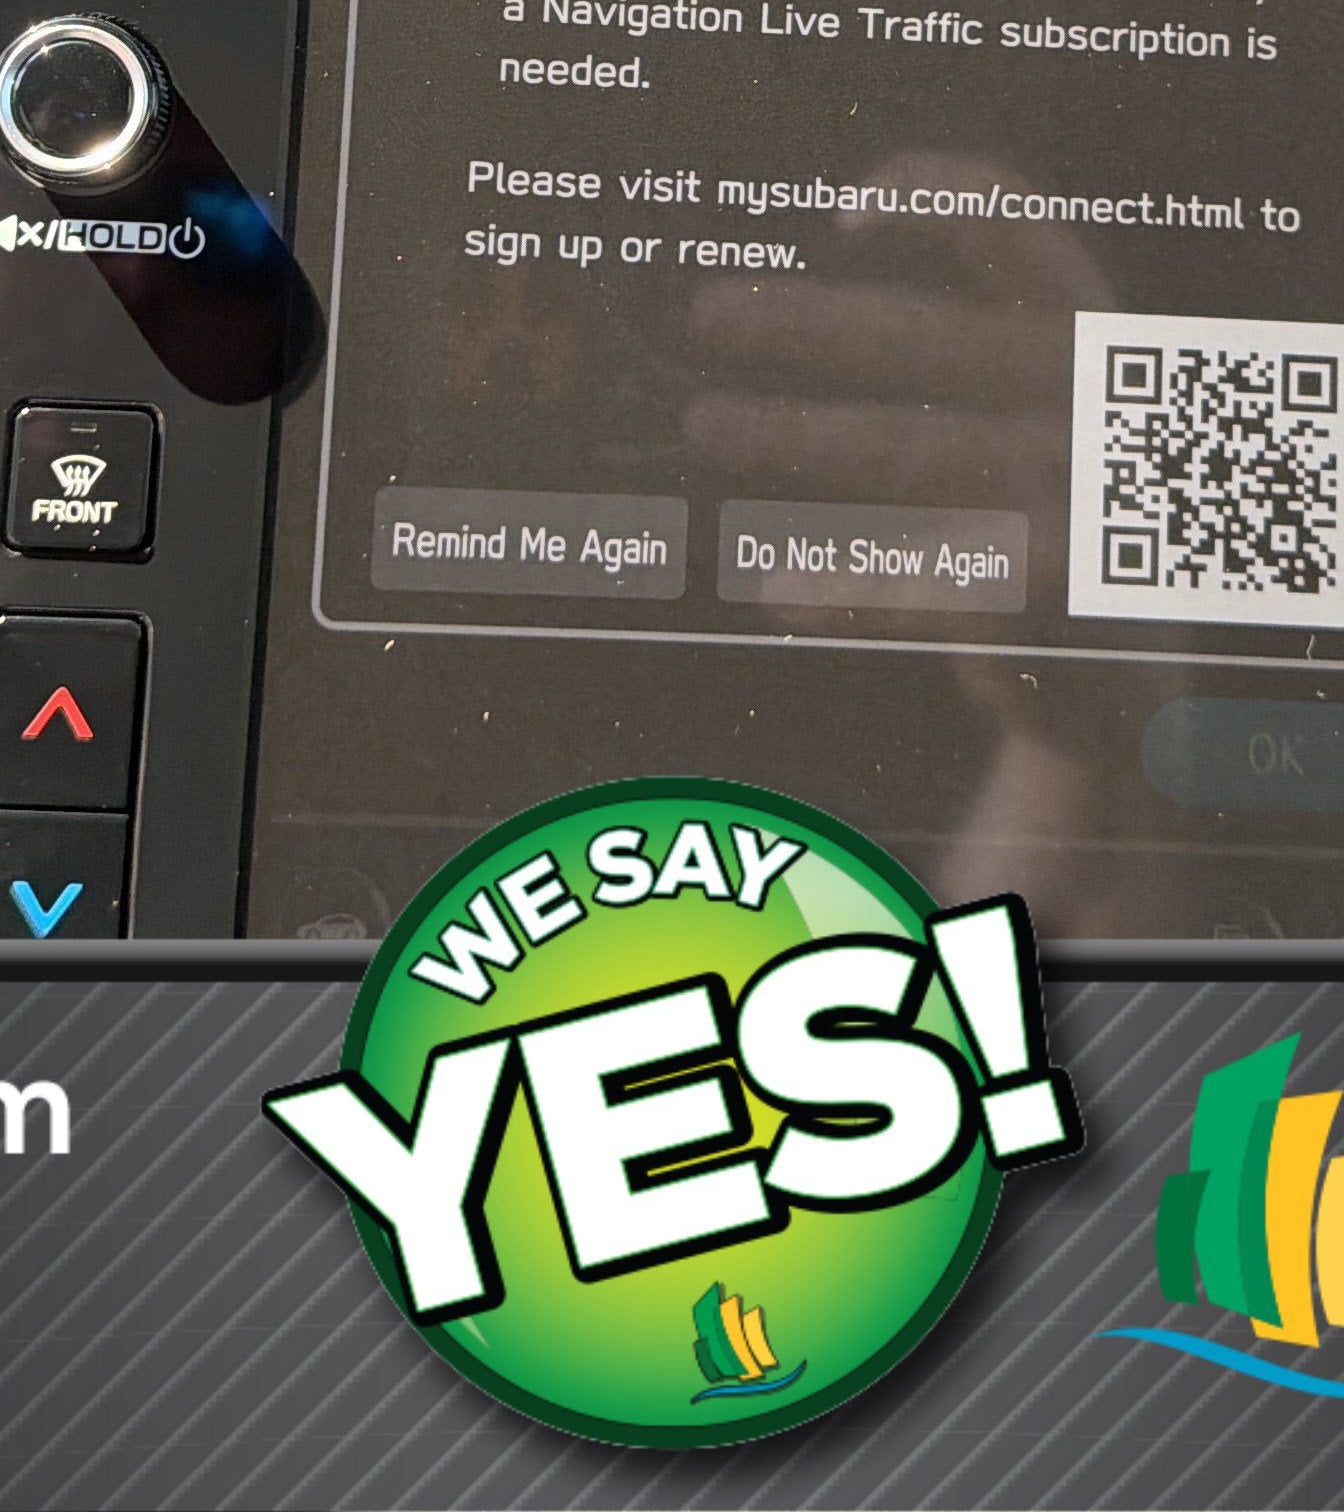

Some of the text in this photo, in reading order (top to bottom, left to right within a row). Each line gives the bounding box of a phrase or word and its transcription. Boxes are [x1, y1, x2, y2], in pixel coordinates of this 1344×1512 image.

[760, 1, 841, 39] Live
[856, 6, 983, 46] Traffic
[1000, 16, 1231, 62] subscription
[1247, 26, 1278, 61] is
[499, 54, 650, 89] needed.
[468, 160, 1301, 233] Please visit mysubaru.com/connect.html to
[464, 222, 806, 270] sign up or renew.
[31, 497, 118, 525] FRONT
[392, 521, 668, 575] Remind Me Again
[737, 535, 1010, 585] Do Not Show Again
[1247, 732, 1304, 776] OK
